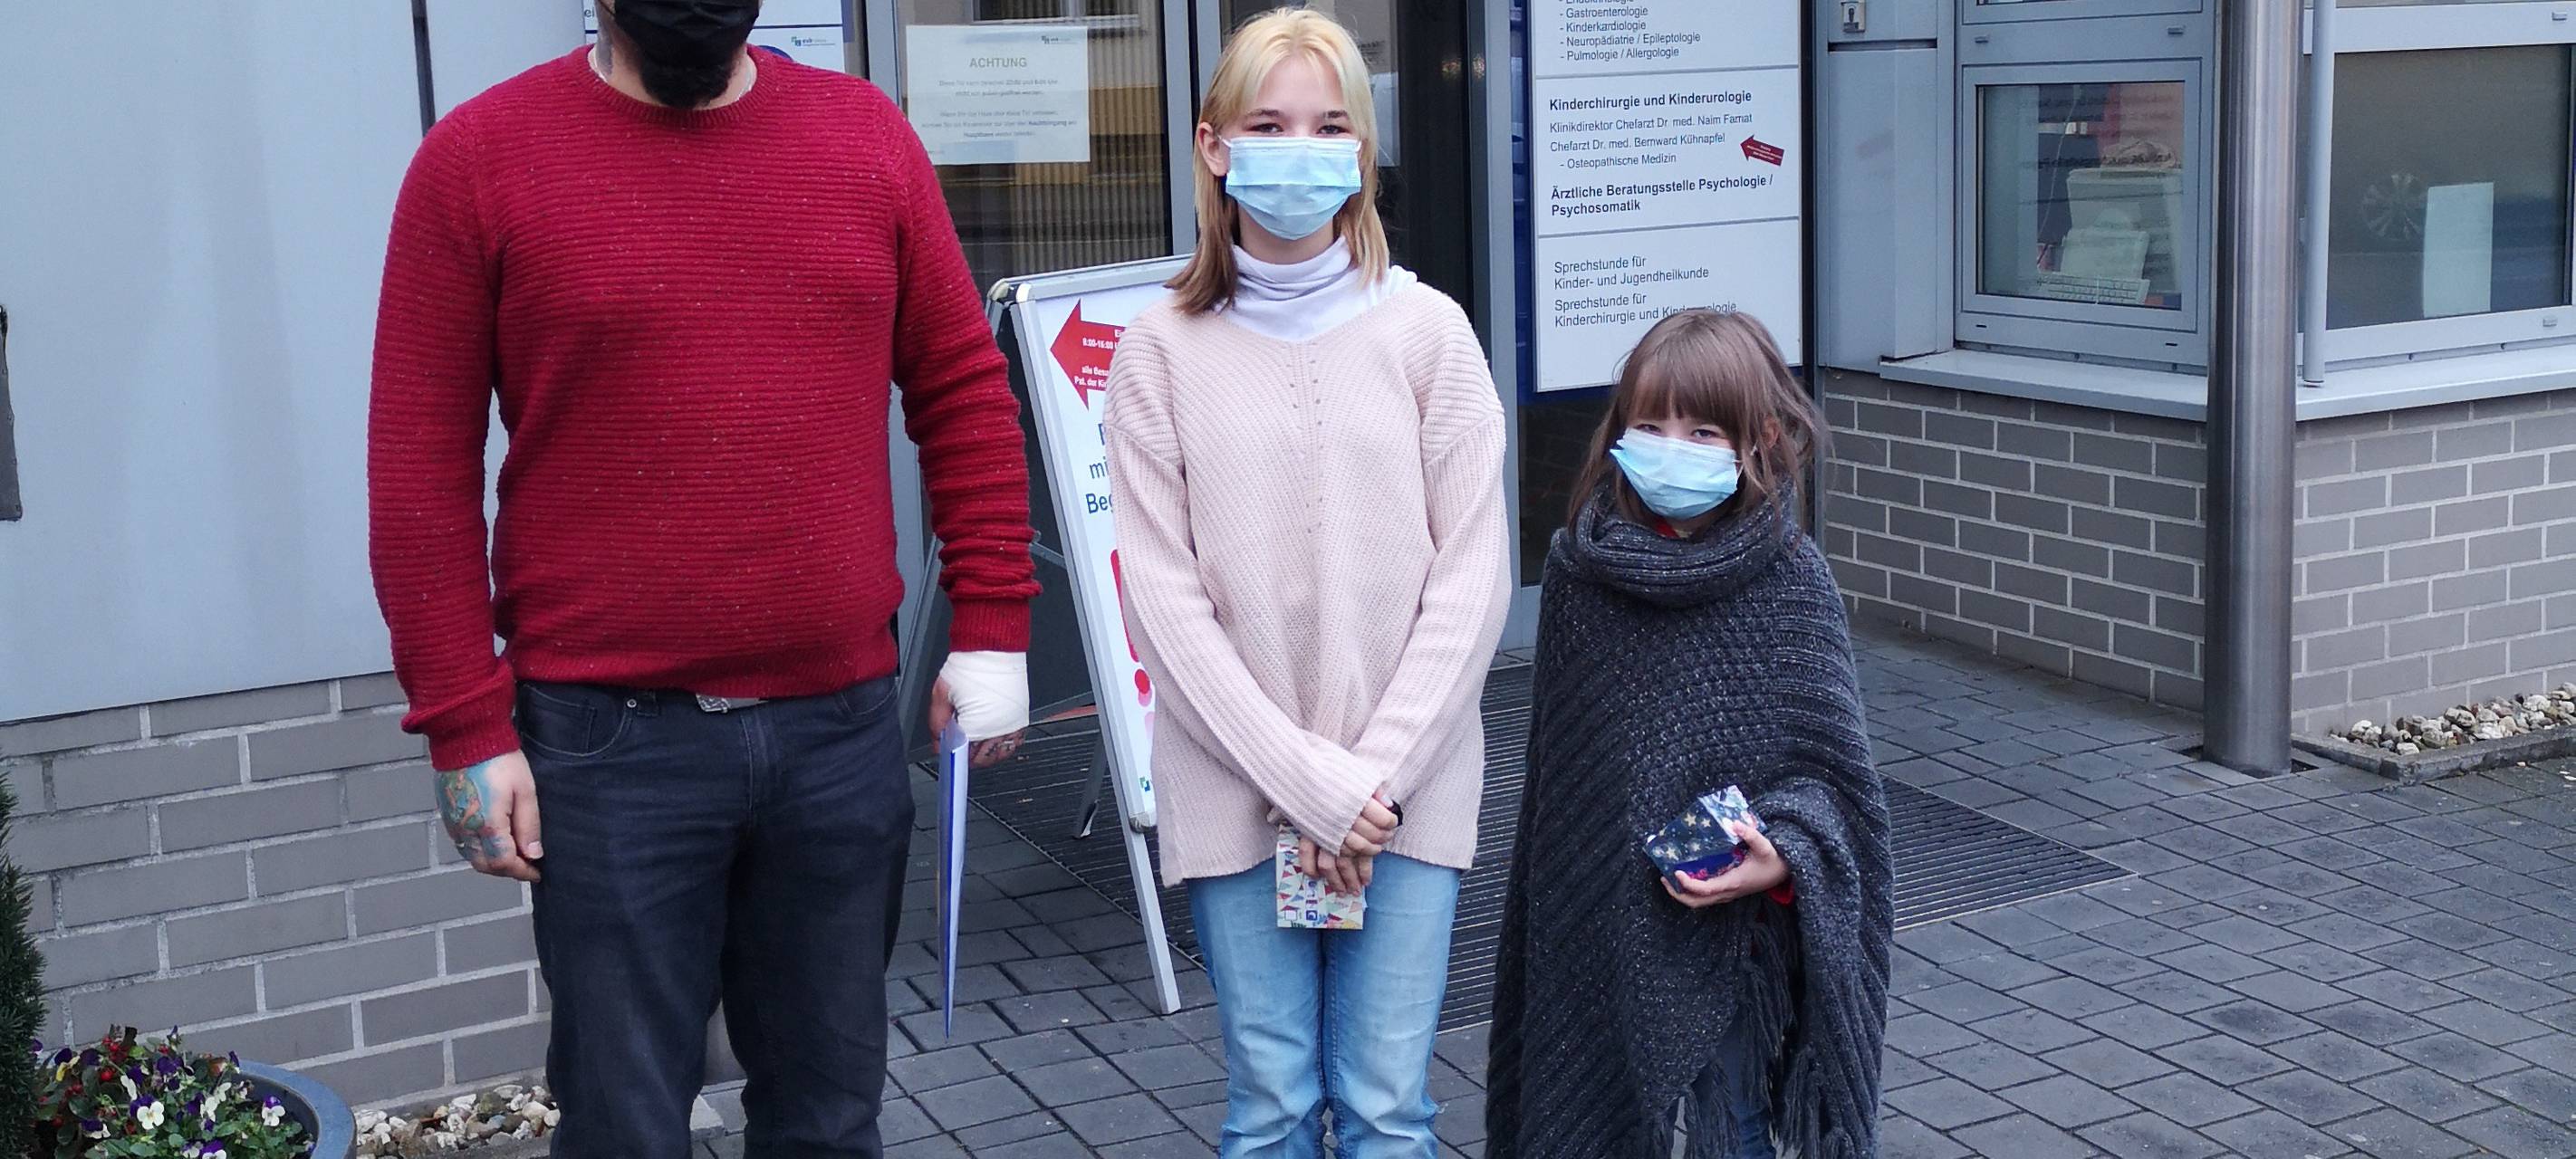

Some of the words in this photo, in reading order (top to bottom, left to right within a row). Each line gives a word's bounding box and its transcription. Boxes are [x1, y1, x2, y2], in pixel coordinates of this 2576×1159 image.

[1566, 6, 1648, 18] Gastroenterologie
[1566, 20, 1647, 33] Kinderkardiologie
[1567, 34, 1635, 48] Neuropädiatrie
[1643, 32, 1701, 45] Epileptologie
[969, 57, 1028, 68] ACHTUNG
[1567, 50, 1619, 62] Pulmologie
[1626, 46, 1679, 60] Allergologie
[1550, 93, 1640, 110] Kinderchirurgie
[1644, 92, 1666, 106] und
[1669, 90, 1752, 105] Kinderurologie
[1550, 120, 1613, 134] Klinikdirektor
[1616, 117, 1655, 131] Chefarzt
[1672, 115, 1695, 128] med.
[1697, 114, 1721, 126] Naim
[1550, 139, 1591, 152] Chefarzt
[1592, 139, 1606, 150] Dr.
[1609, 137, 1630, 149] med.
[1680, 132, 1725, 146] Kühnapfel
[1567, 155, 1639, 170] Osteopathische
[1641, 152, 1677, 166] Medizin
[1551, 183, 1603, 200] Ärztliche
[1606, 178, 1696, 196] Beratungsstelle
[1698, 174, 1767, 191] Psychologie
[1552, 198, 1641, 218] Psychosomatik
[1554, 255, 1629, 274] Sprechstunde
[1631, 254, 1647, 268] für
[1554, 275, 1594, 291] Kinder-
[1597, 273, 1617, 287] und
[1620, 266, 1709, 286] Jugendheilkunde
[1554, 293, 1629, 312] Sprechstunde
[1632, 292, 1647, 306] für
[1554, 310, 1636, 329] Kinderchirurgie
[1639, 307, 1659, 321] und
[1090, 455, 1110, 479] mi
